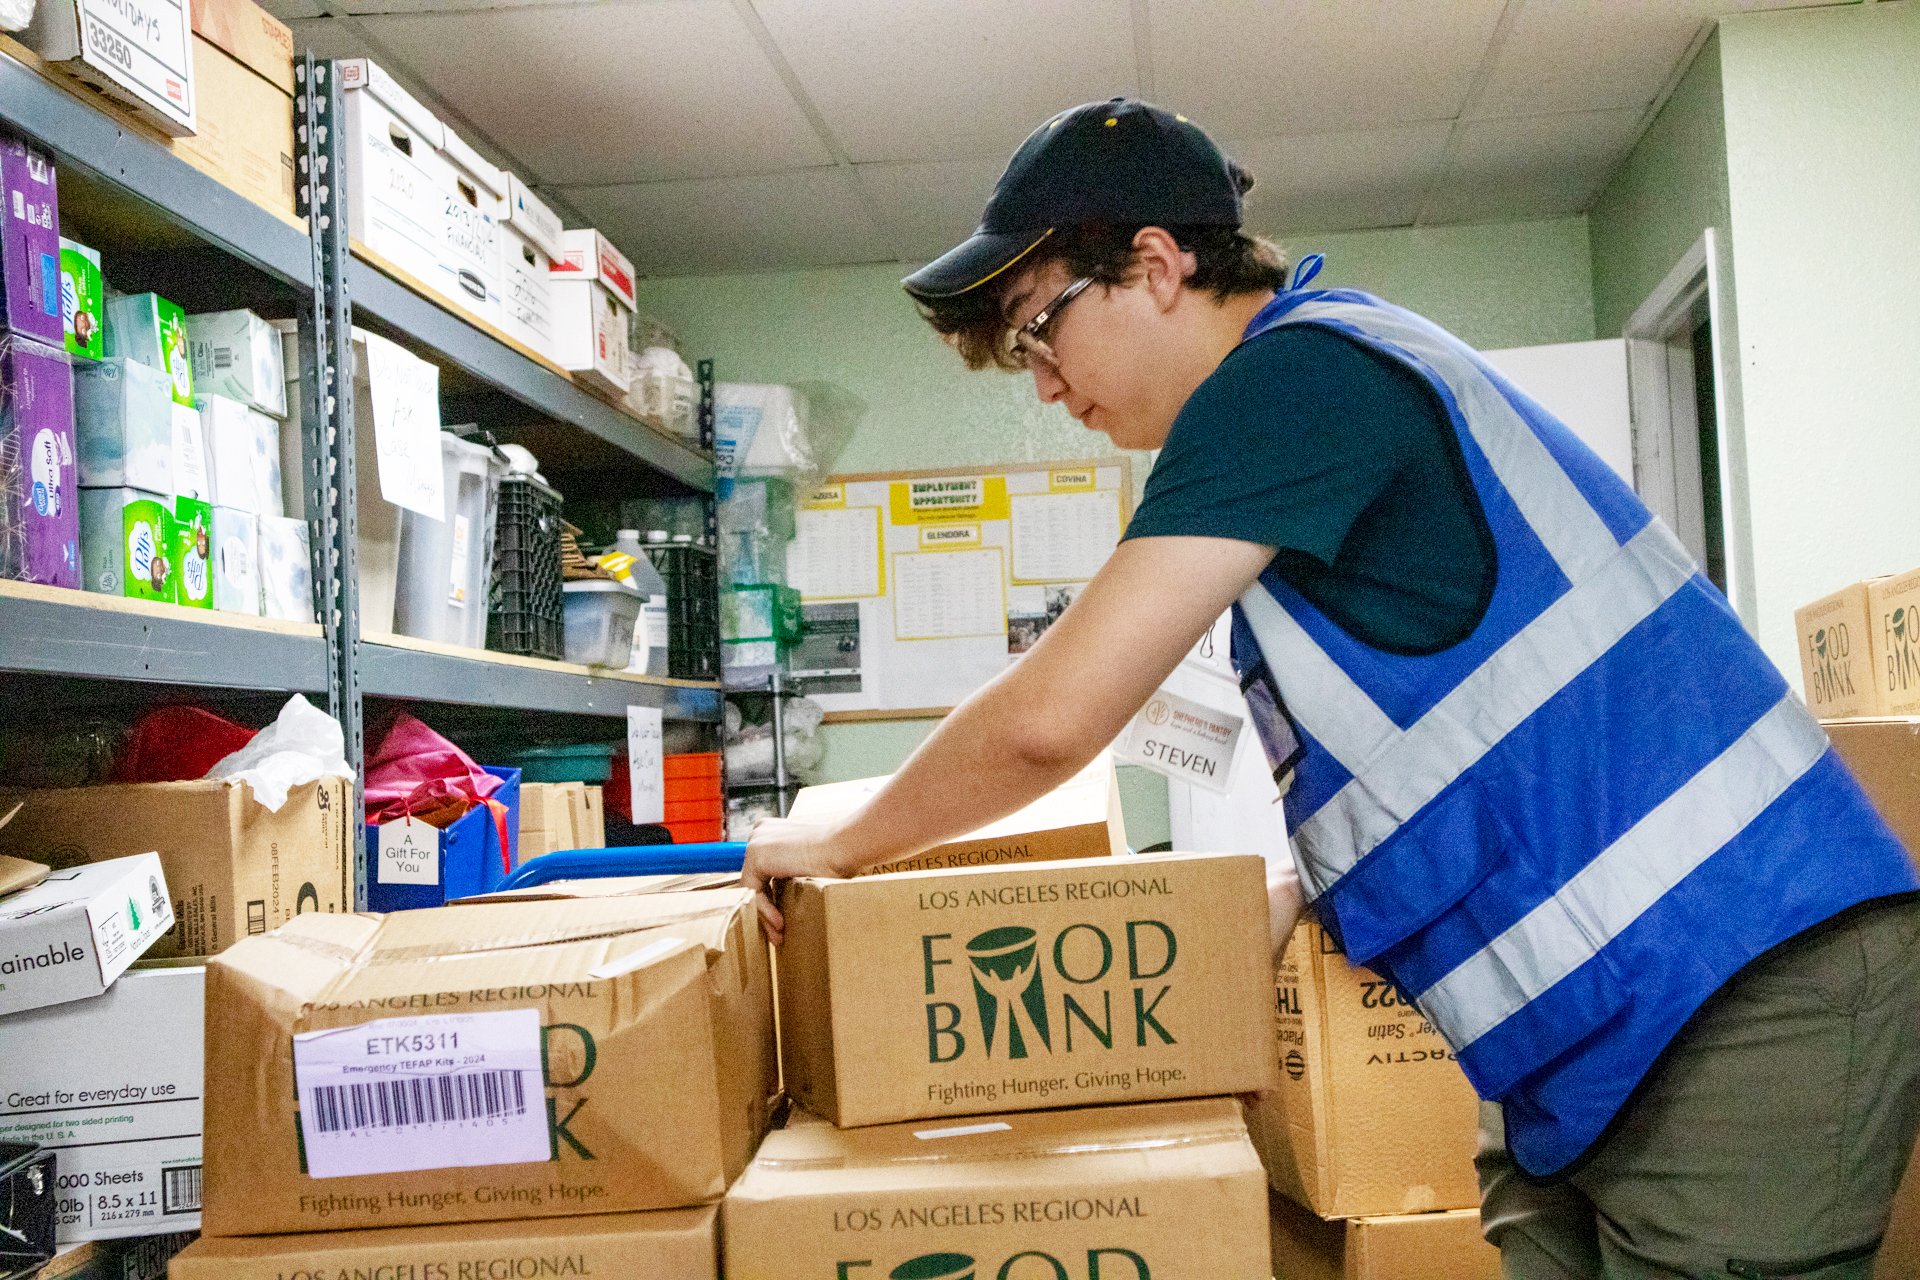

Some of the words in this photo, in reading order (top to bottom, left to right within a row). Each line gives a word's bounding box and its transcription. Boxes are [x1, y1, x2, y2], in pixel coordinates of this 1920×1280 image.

[102, 0, 160, 42] LIDAYS
[89, 21, 132, 70] 33250
[44, 440, 53, 466] Soft
[912, 481, 977, 494] EMPLOYMENT
[1055, 474, 1088, 484] COVINA
[926, 530, 970, 540] GLENDORA
[135, 529, 150, 572] Puffs
[186, 557, 205, 591] Puffs
[1884, 604, 1920, 651] FOO
[1887, 643, 1920, 692] BAN
[1813, 657, 1856, 705] BANK
[1142, 739, 1217, 778] STEVEN
[385, 846, 407, 860] Gift
[410, 848, 431, 860] For
[403, 834, 413, 846] A
[395, 860, 420, 874] You
[871, 855, 944, 877] ANGELES
[947, 843, 1034, 870] REGIONAL
[270, 842, 281, 914] 08FEB2024
[918, 889, 960, 911] LOS
[965, 884, 1060, 907] ANGELES
[1065, 876, 1174, 902] REGIONAL
[0, 940, 85, 976] ainable
[468, 981, 599, 1002] REGIONAL
[366, 1032, 459, 1056] ETK5311
[1367, 1023, 1405, 1041] Satin
[342, 1064, 397, 1075] Emergency
[400, 1059, 433, 1071] TEFAP
[435, 1057, 454, 1067] Kits
[463, 1054, 486, 1065] 2024
[7, 1093, 51, 1108] Great
[55, 1090, 74, 1105] for
[79, 1084, 148, 1103] everyday
[151, 1083, 176, 1095] use
[928, 1082, 998, 1104] Fighting
[1002, 1075, 1069, 1099] Hunger.
[1075, 1070, 1132, 1091] Giving
[1136, 1066, 1187, 1087] Hope.
[0, 1125, 14, 1135] per
[15, 1121, 51, 1135] designed
[53, 1120, 64, 1129] for
[66, 1118, 80, 1127] two
[81, 1116, 104, 1126] sided
[104, 1114, 134, 1126] printing
[55, 1174, 90, 1190] 000
[94, 1170, 144, 1186] Sheets
[97, 1195, 122, 1210] 8.5
[125, 1195, 134, 1207] x
[139, 1192, 158, 1206] 11
[299, 1194, 381, 1218] Fighting
[388, 1188, 467, 1211] Hunger.
[474, 1184, 542, 1206] Giving
[549, 1181, 609, 1201] Hope.
[61, 1214, 81, 1225] GSM
[101, 1211, 117, 1221] 216
[124, 1209, 141, 1219] 279
[832, 1208, 882, 1232] LOS
[890, 1202, 1006, 1228] ANGELES
[1013, 1197, 1149, 1223] REGIONAL
[336, 1260, 449, 1280] ANGELES
[459, 1254, 591, 1279] REGIONAL
